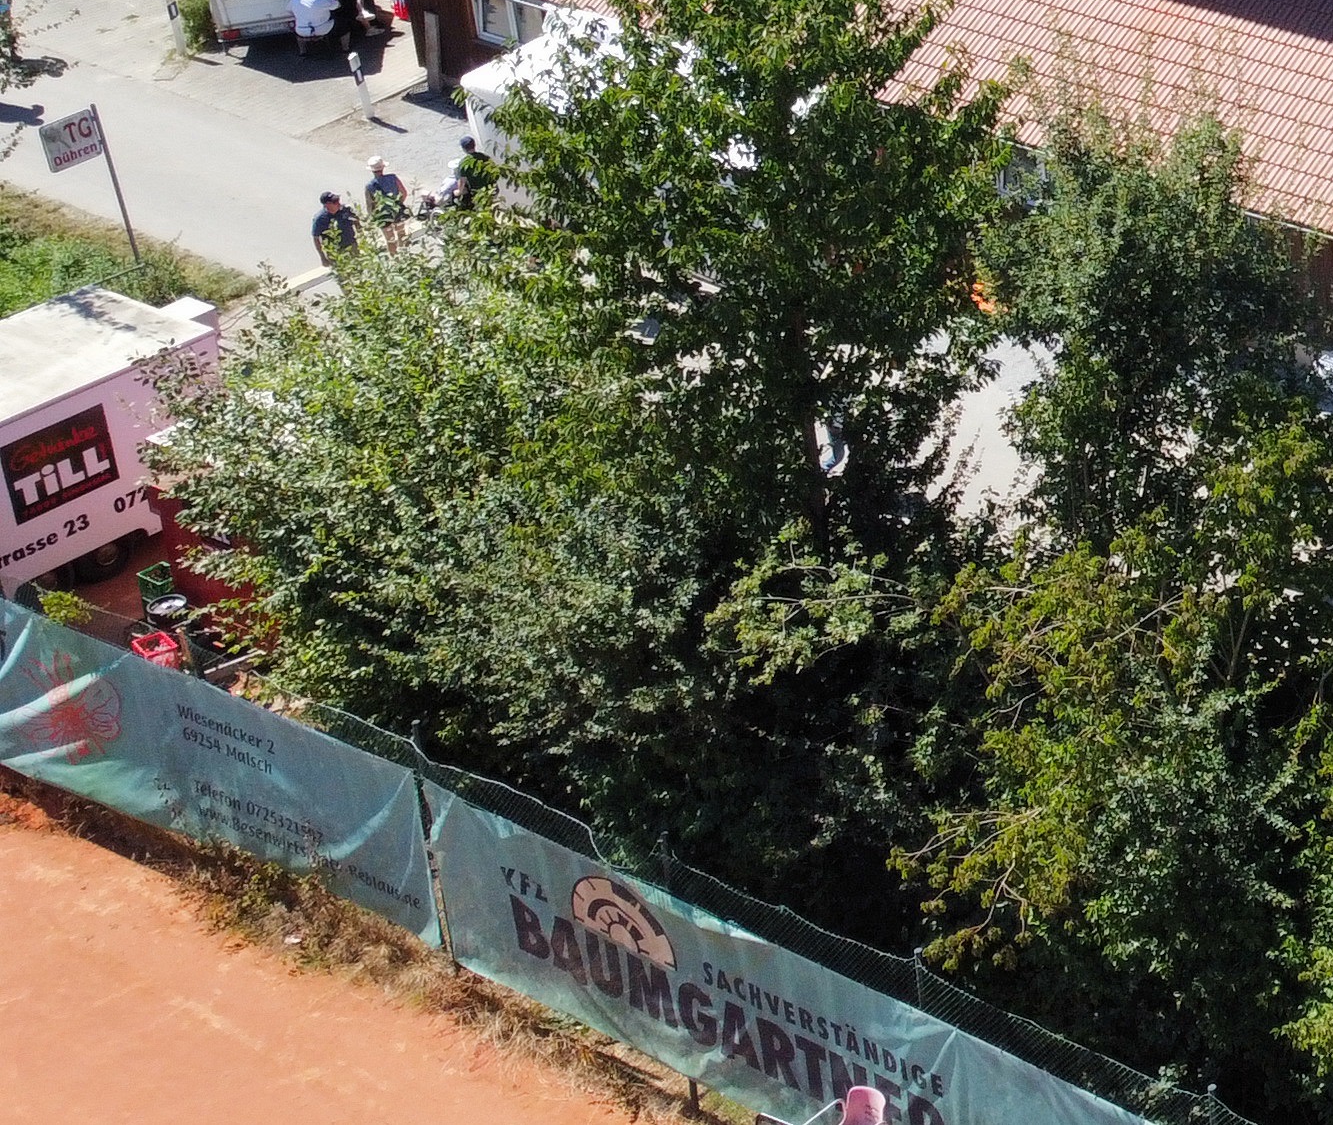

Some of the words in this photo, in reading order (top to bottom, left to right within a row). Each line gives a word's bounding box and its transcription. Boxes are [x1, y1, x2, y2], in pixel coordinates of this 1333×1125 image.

[63, 117, 92, 143] TG
[53, 143, 98, 166] Dühren
[64, 513, 91, 538] 23
[177, 703, 263, 749] Wiesenäcker
[267, 739, 275, 755] 2
[183, 726, 222, 754] 69254
[226, 743, 273, 774] Malsch
[194, 779, 242, 813] Telefon
[702, 961, 945, 1098] SACHVERSTÄNDIGE
